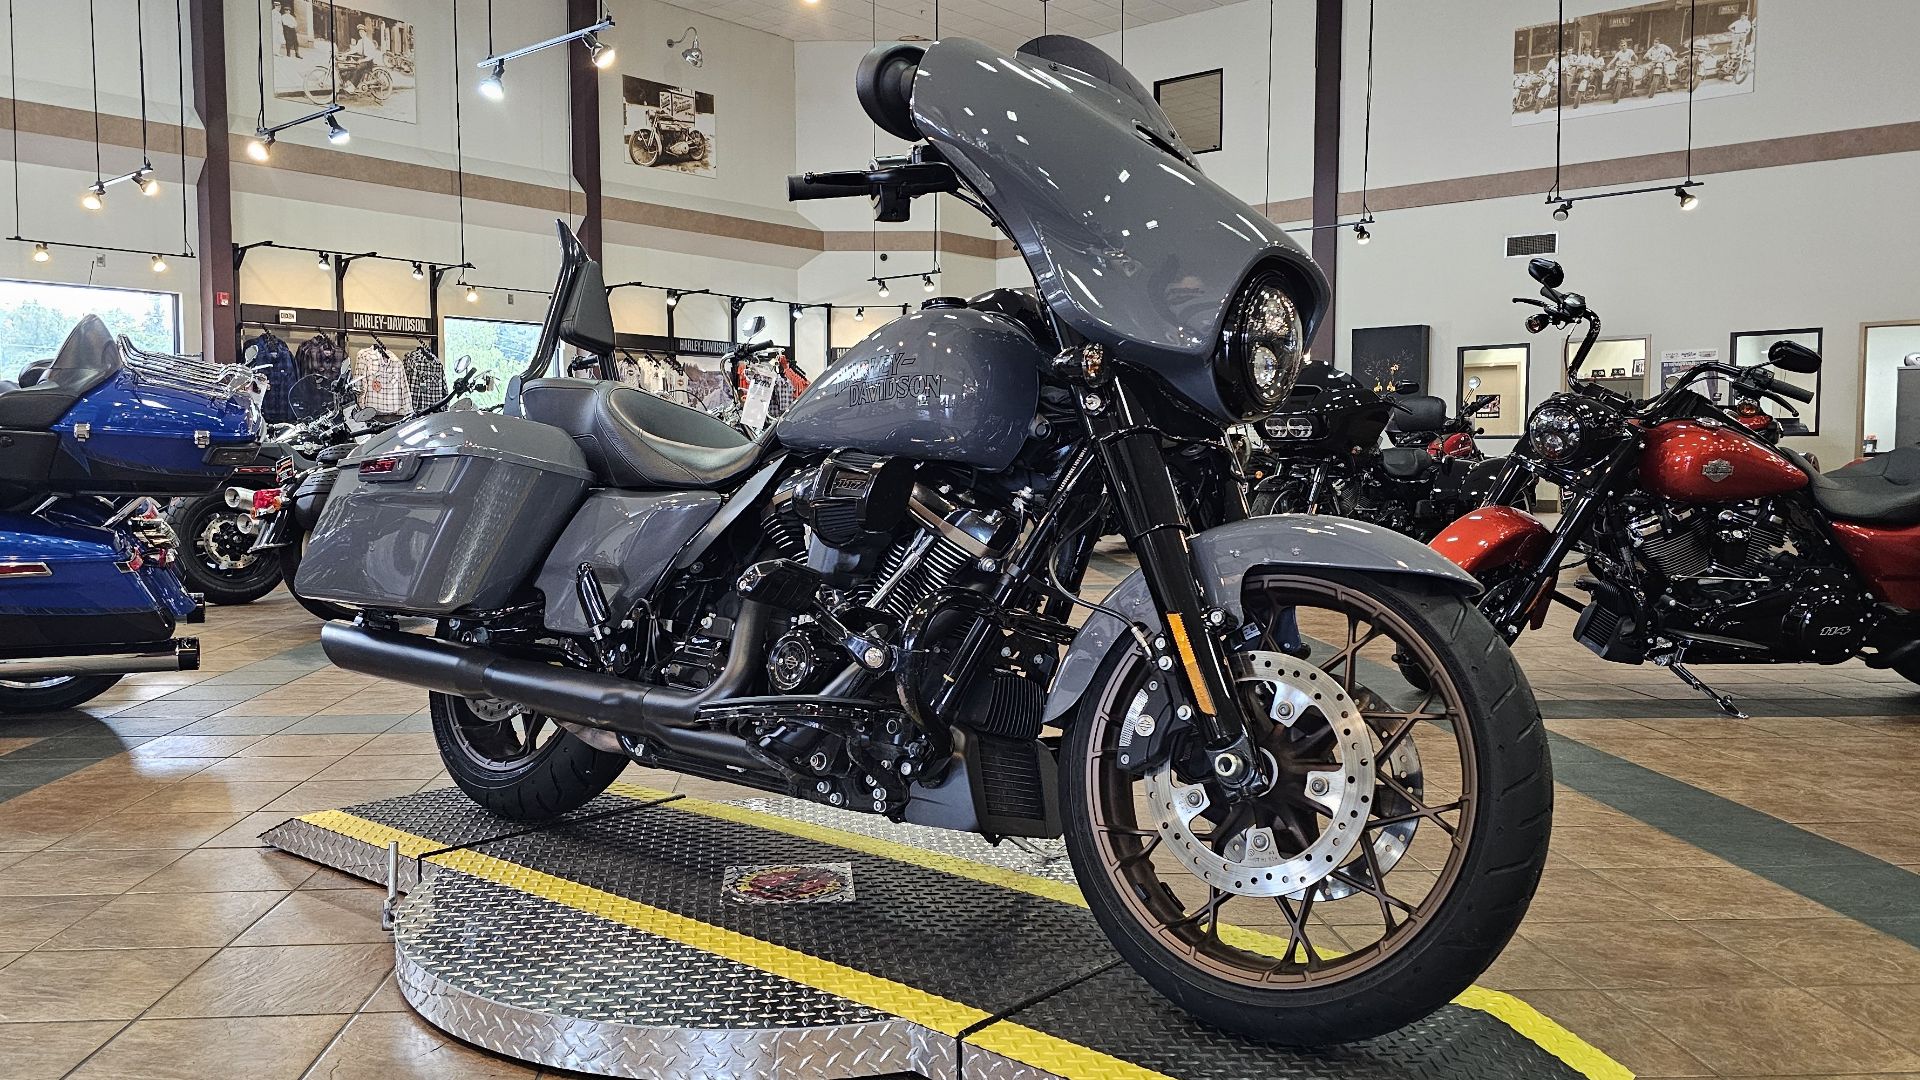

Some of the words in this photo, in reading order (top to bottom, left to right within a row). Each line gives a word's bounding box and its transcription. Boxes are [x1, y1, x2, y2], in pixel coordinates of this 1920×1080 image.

[353, 313, 427, 333] HARLEY-DAVIDSON
[680, 339, 730, 354] HARLEY-DAVIDSON
[849, 374, 942, 407] DAVIDSON
[1820, 625, 1851, 636] 114
